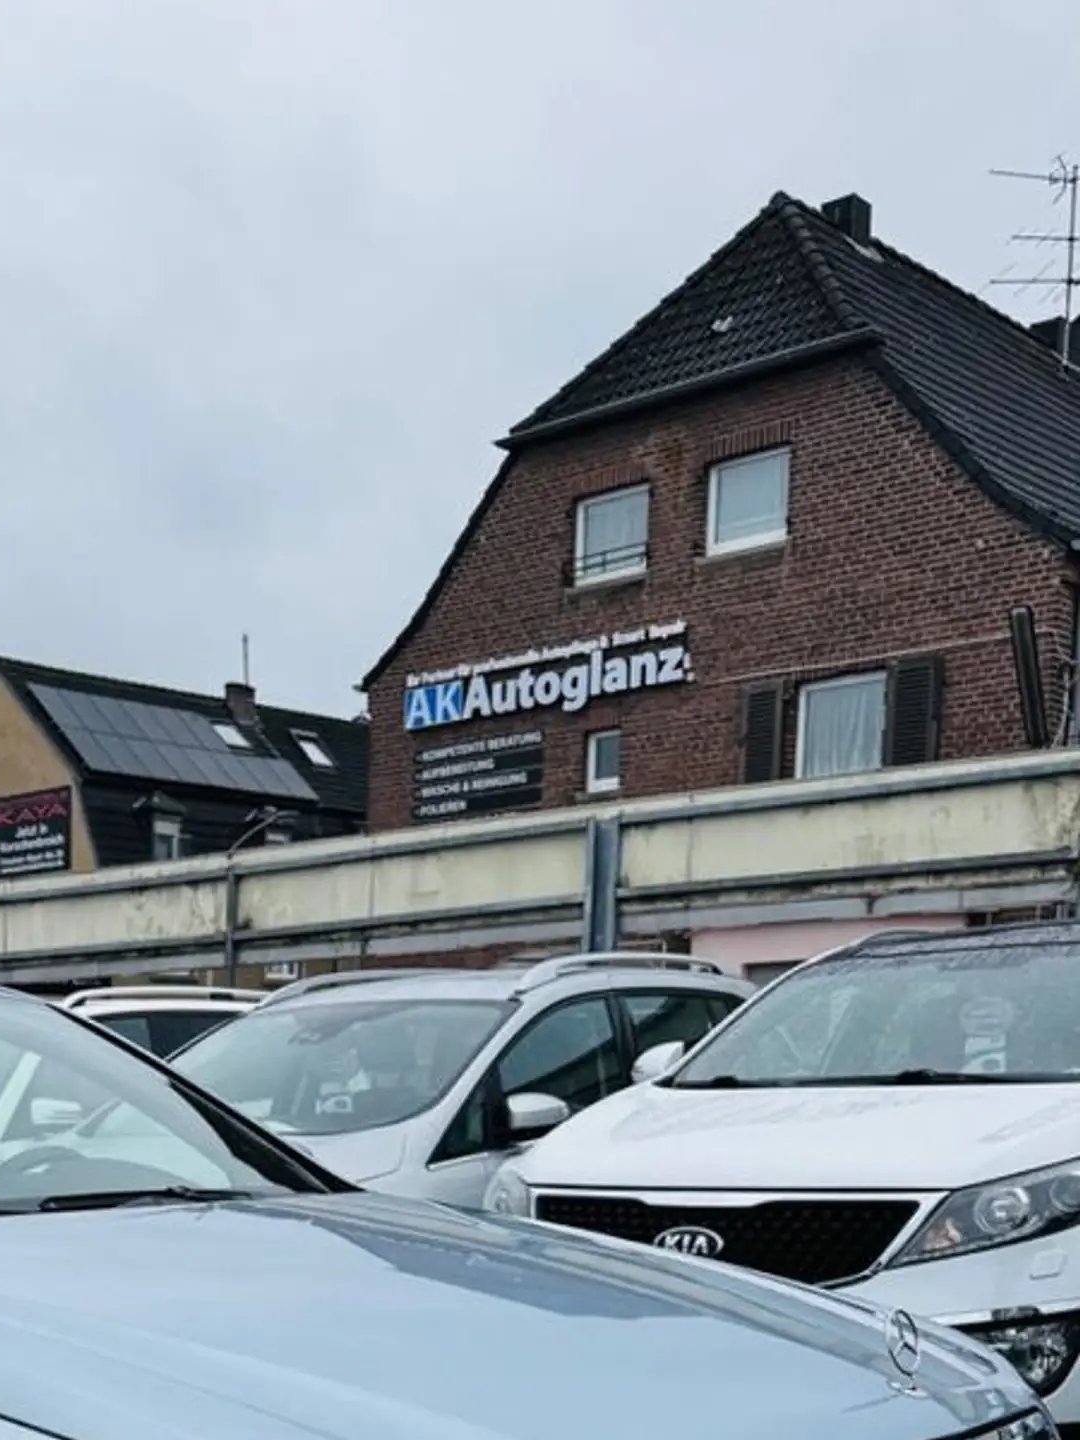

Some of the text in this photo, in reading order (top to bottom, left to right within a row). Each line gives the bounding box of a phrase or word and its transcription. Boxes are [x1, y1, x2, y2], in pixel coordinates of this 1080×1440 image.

[405, 680, 464, 730] AK
[487, 731, 542, 751] BERATUNG
[663, 1233, 709, 1254] KIA
